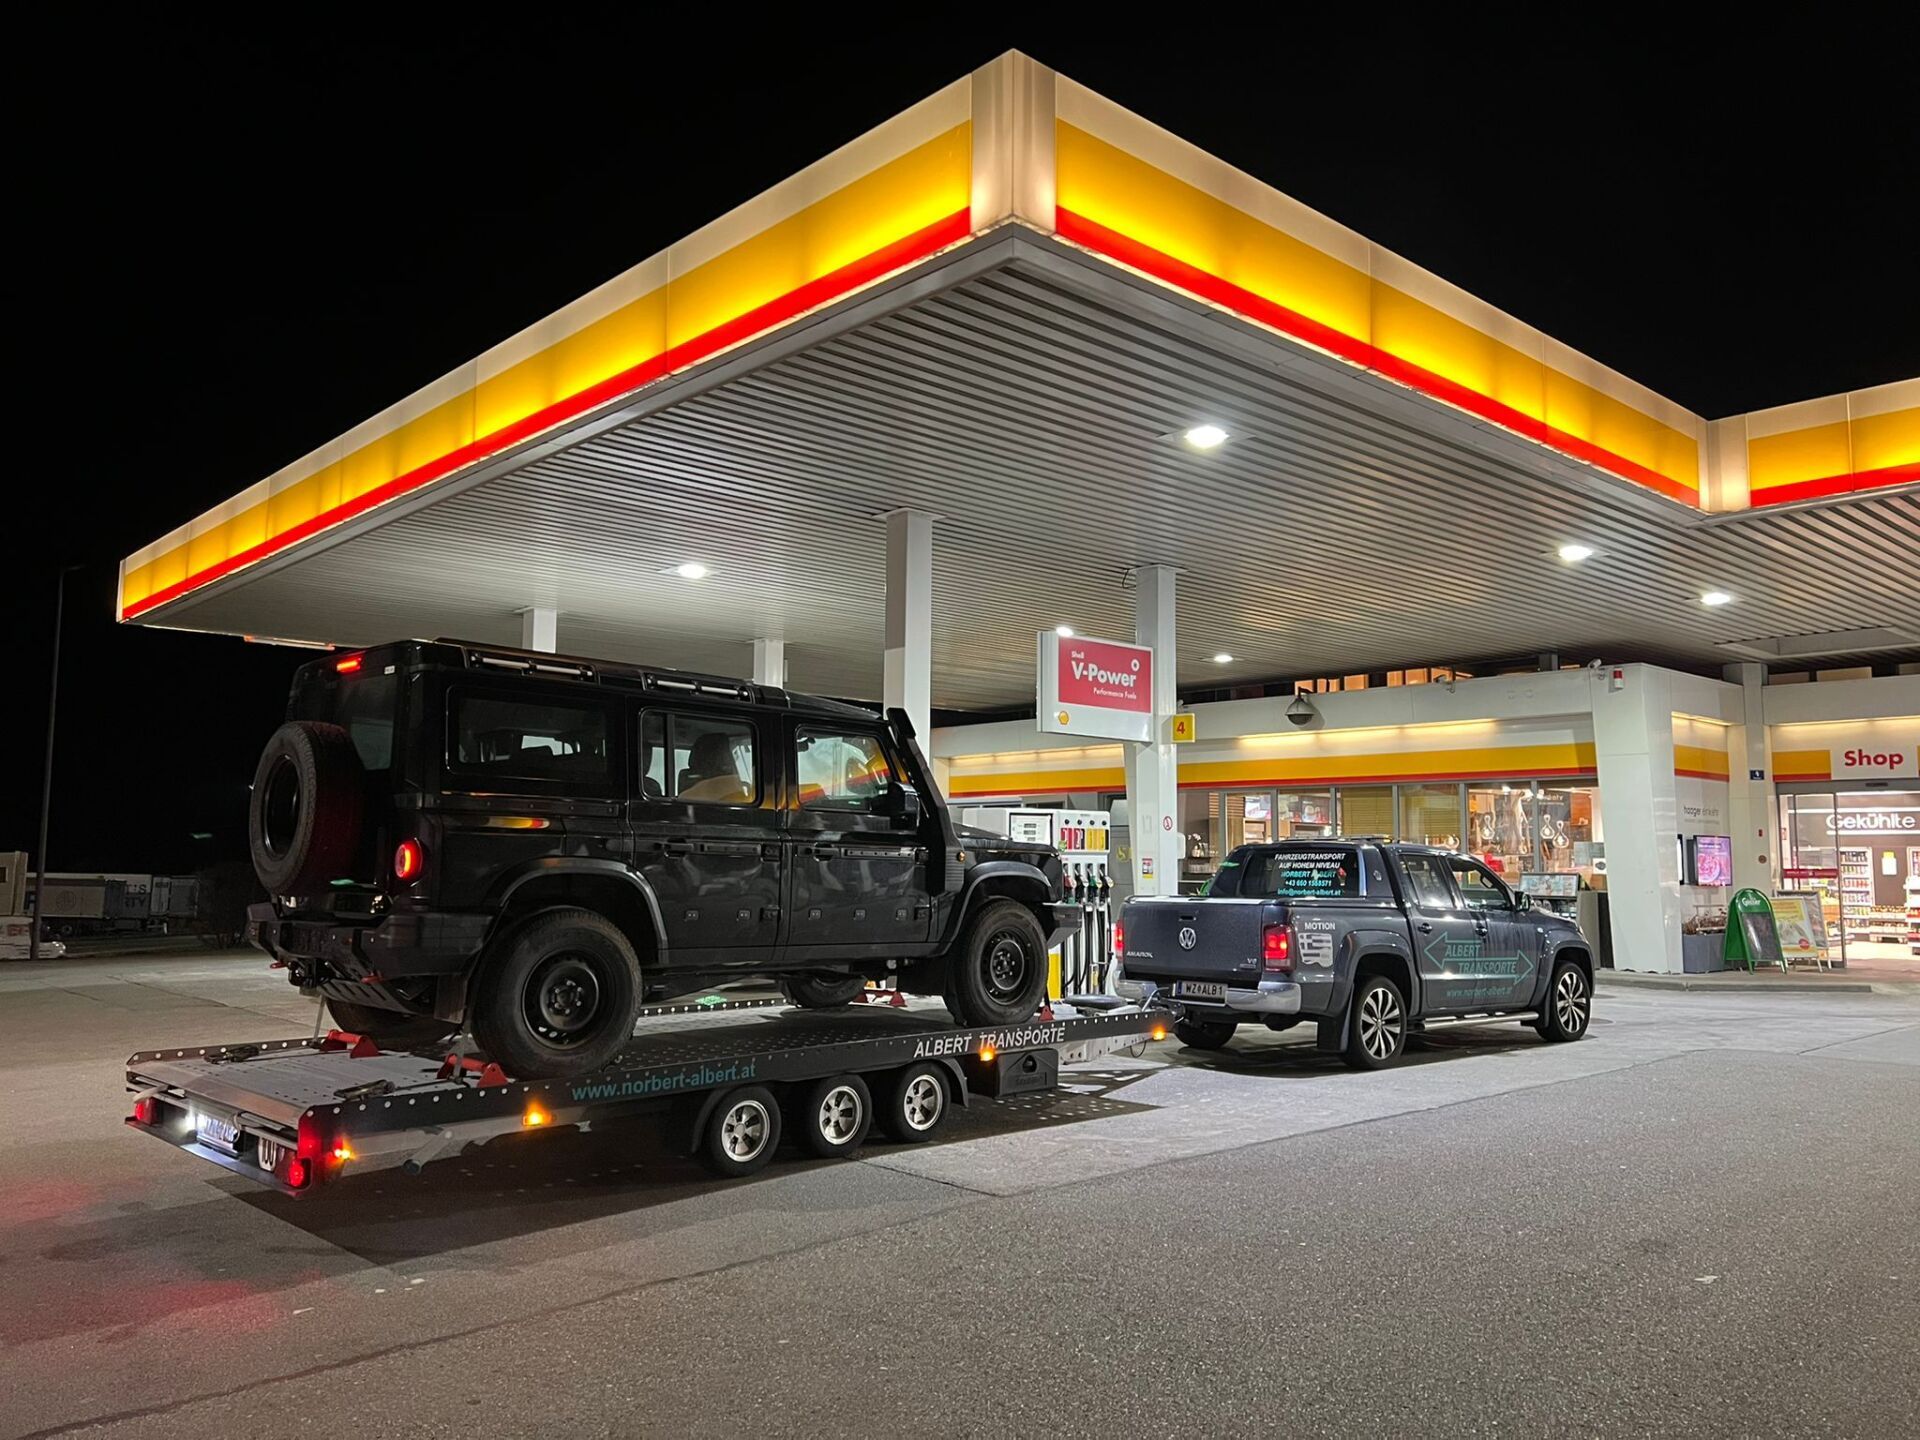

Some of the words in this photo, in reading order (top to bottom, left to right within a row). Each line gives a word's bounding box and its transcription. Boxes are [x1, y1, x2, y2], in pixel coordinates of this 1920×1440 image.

[1071, 651, 1084, 659] Shell
[1071, 660, 1137, 687] V-Power
[1093, 687, 1124, 698] Performance
[1176, 721, 1185, 735] 4
[1844, 749, 1904, 770] Shop
[1826, 813, 1916, 829] Gekühlte
[1274, 853, 1346, 861] FAHRZEUGTRANSPORT
[1281, 870, 1311, 878] NORBERT
[1304, 922, 1336, 931] MOTION
[1445, 944, 1480, 957] ALBERT
[1458, 961, 1517, 973] TRANSPORTE
[913, 1036, 973, 1058] ALBERT
[979, 1027, 1066, 1051] TRANSPORTE
[572, 1063, 756, 1101] www.norbert-albert.at
